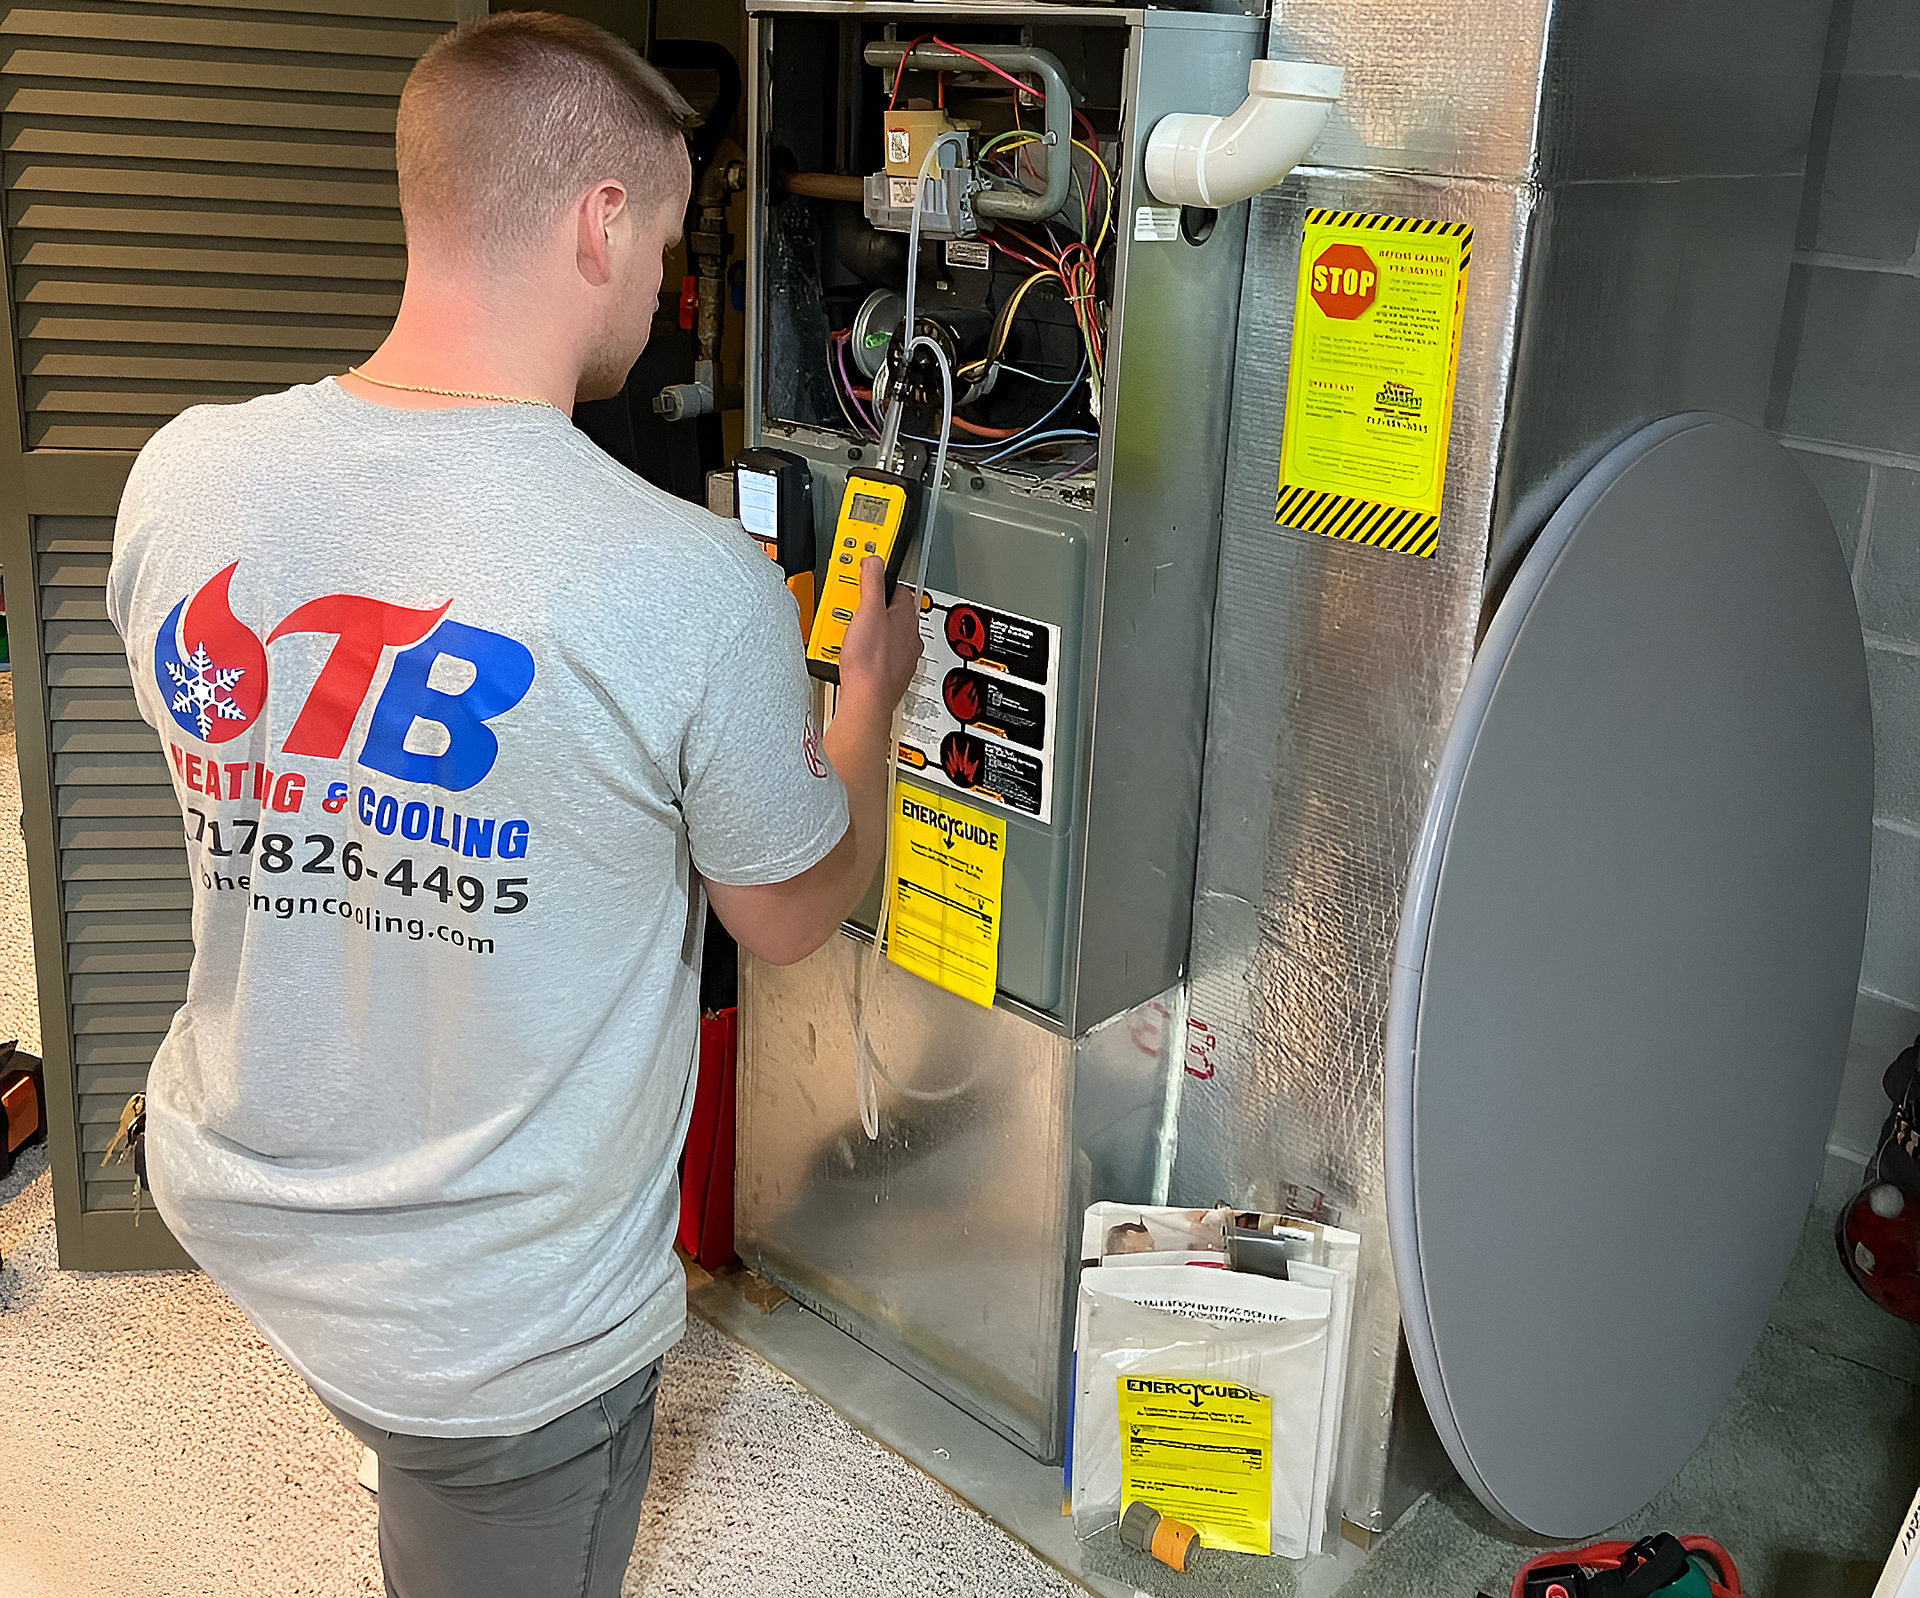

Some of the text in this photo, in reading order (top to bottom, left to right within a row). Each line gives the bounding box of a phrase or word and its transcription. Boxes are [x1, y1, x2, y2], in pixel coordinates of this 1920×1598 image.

[1313, 265, 1375, 298] STOP
[322, 782, 348, 814] &
[358, 786, 530, 859] COOLING
[902, 798, 999, 851] ENERGYGUIDE
